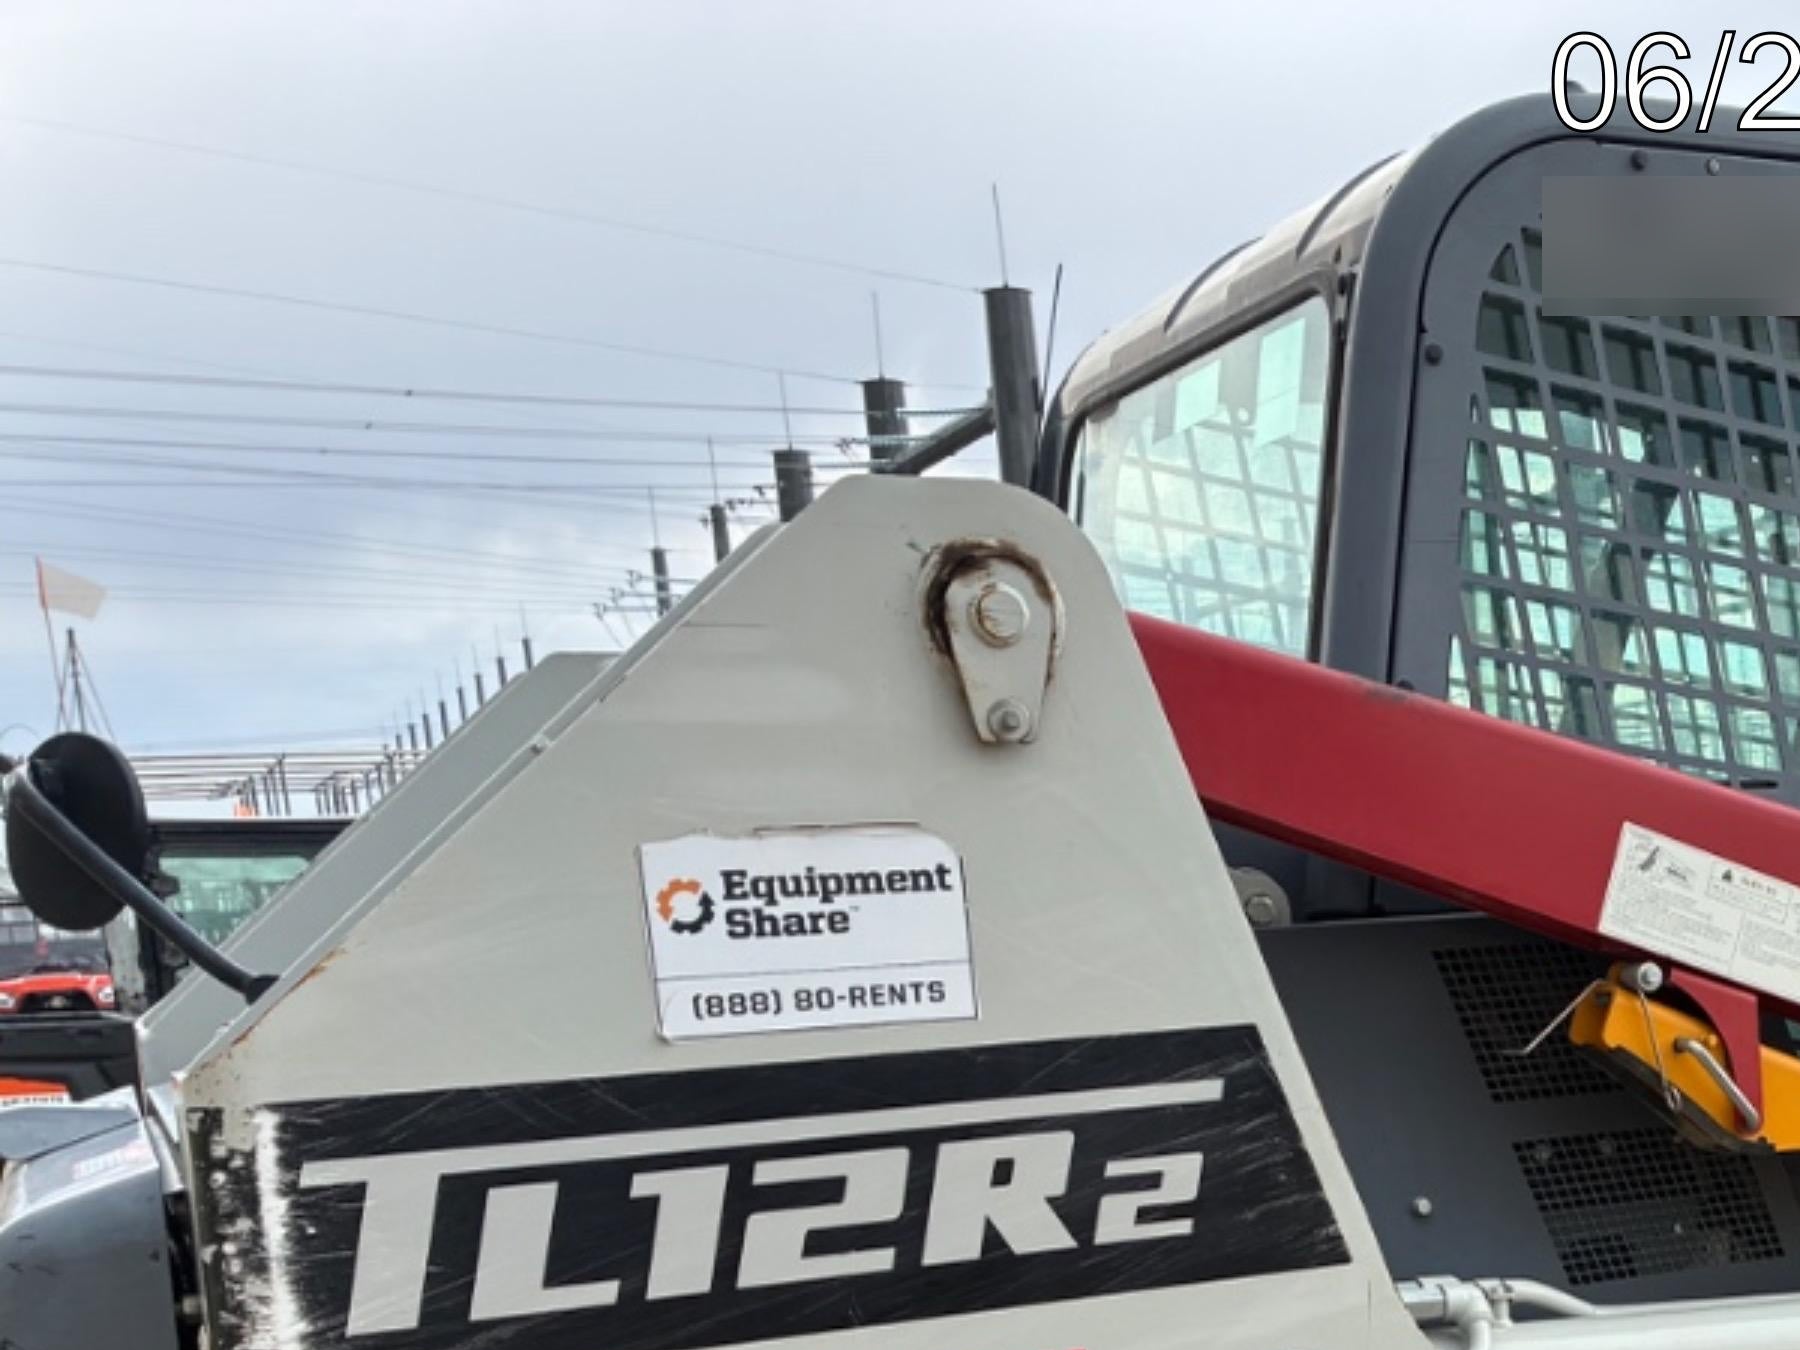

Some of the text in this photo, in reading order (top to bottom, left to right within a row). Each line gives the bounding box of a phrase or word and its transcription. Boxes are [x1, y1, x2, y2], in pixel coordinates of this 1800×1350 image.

[720, 863, 953, 906] Equipment
[726, 908, 851, 940] Share
[692, 980, 947, 1020] (888) 80-RENTS
[300, 1078, 1223, 1337] TL12R2
